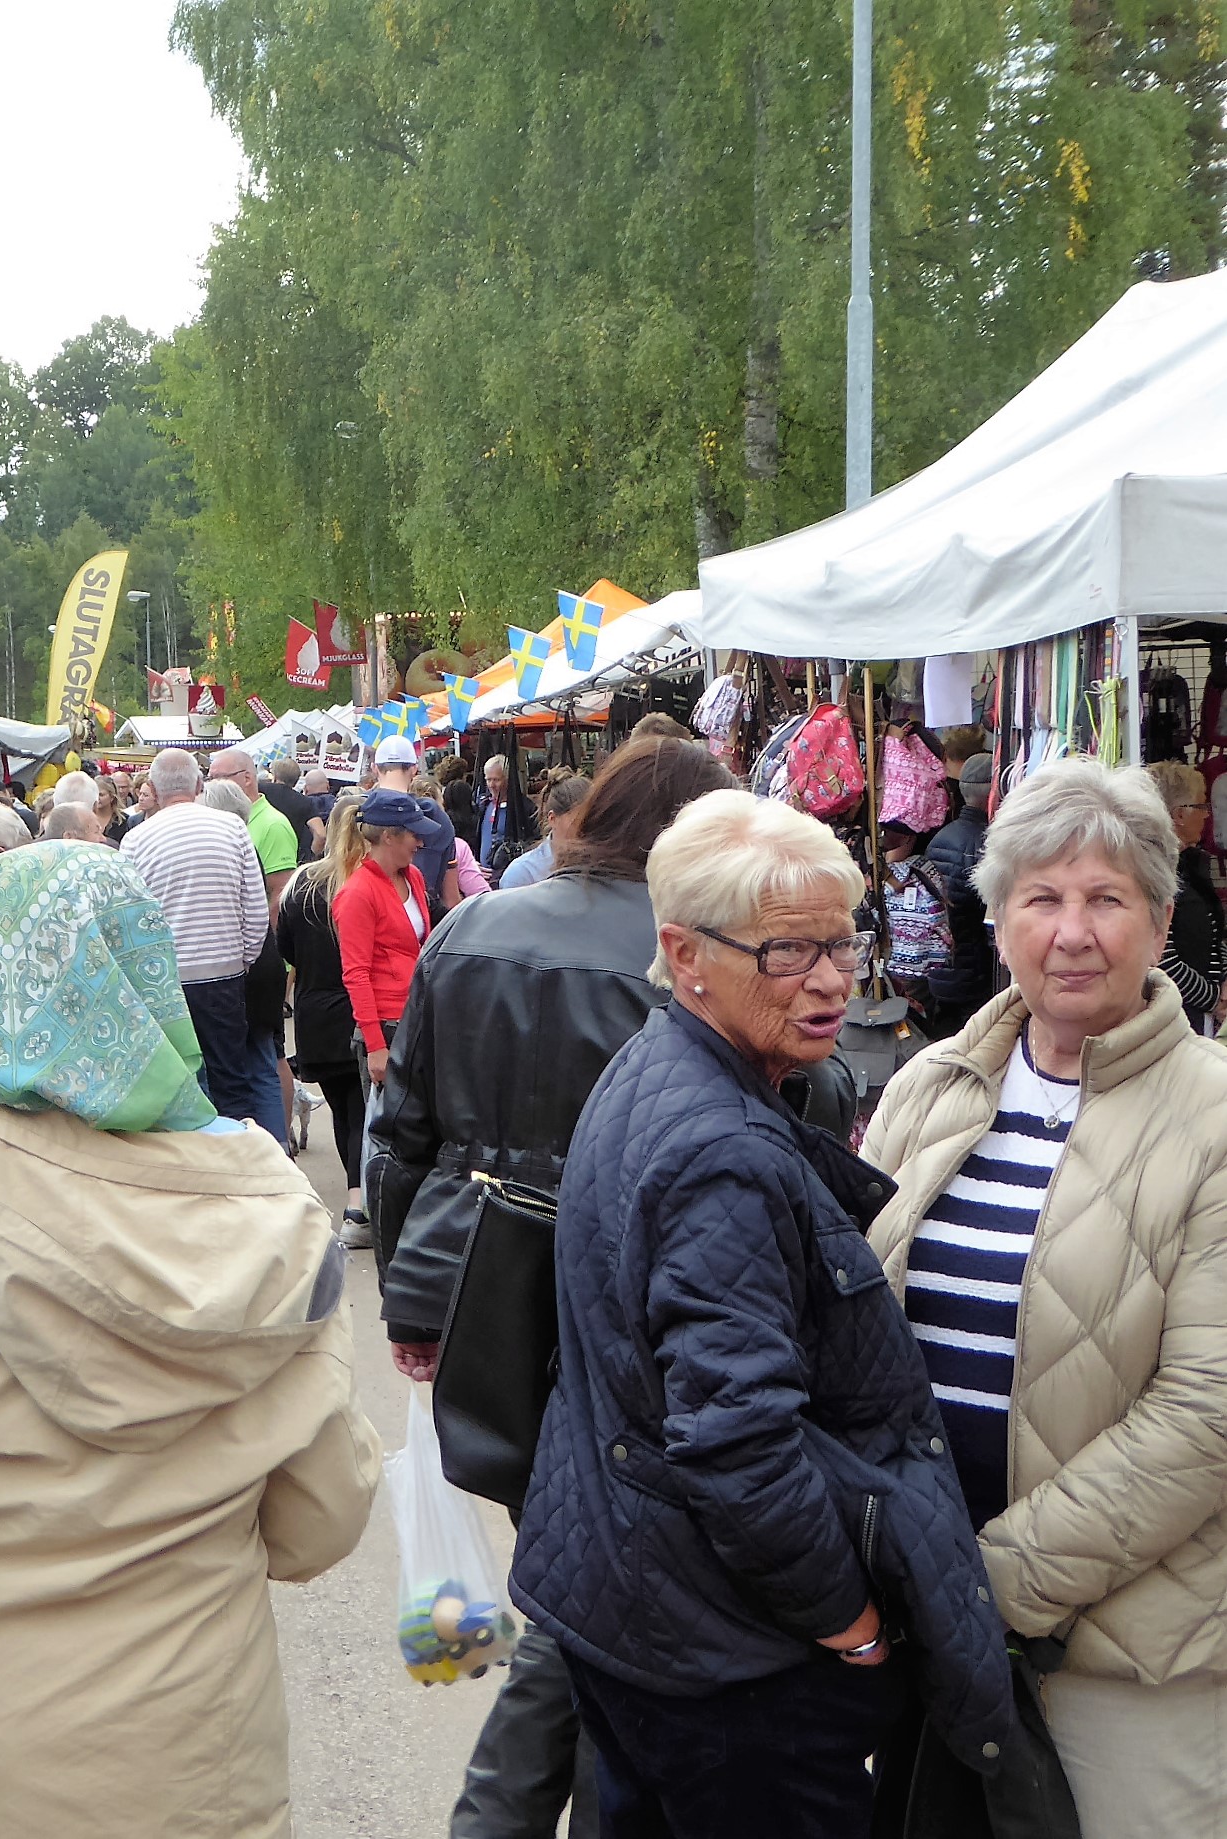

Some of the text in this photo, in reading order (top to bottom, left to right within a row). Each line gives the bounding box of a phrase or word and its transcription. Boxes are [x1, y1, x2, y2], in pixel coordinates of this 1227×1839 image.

[322, 652, 365, 663] MJUKGLASS
[295, 666, 316, 676] SOFT
[286, 673, 326, 687] ICECREAM
